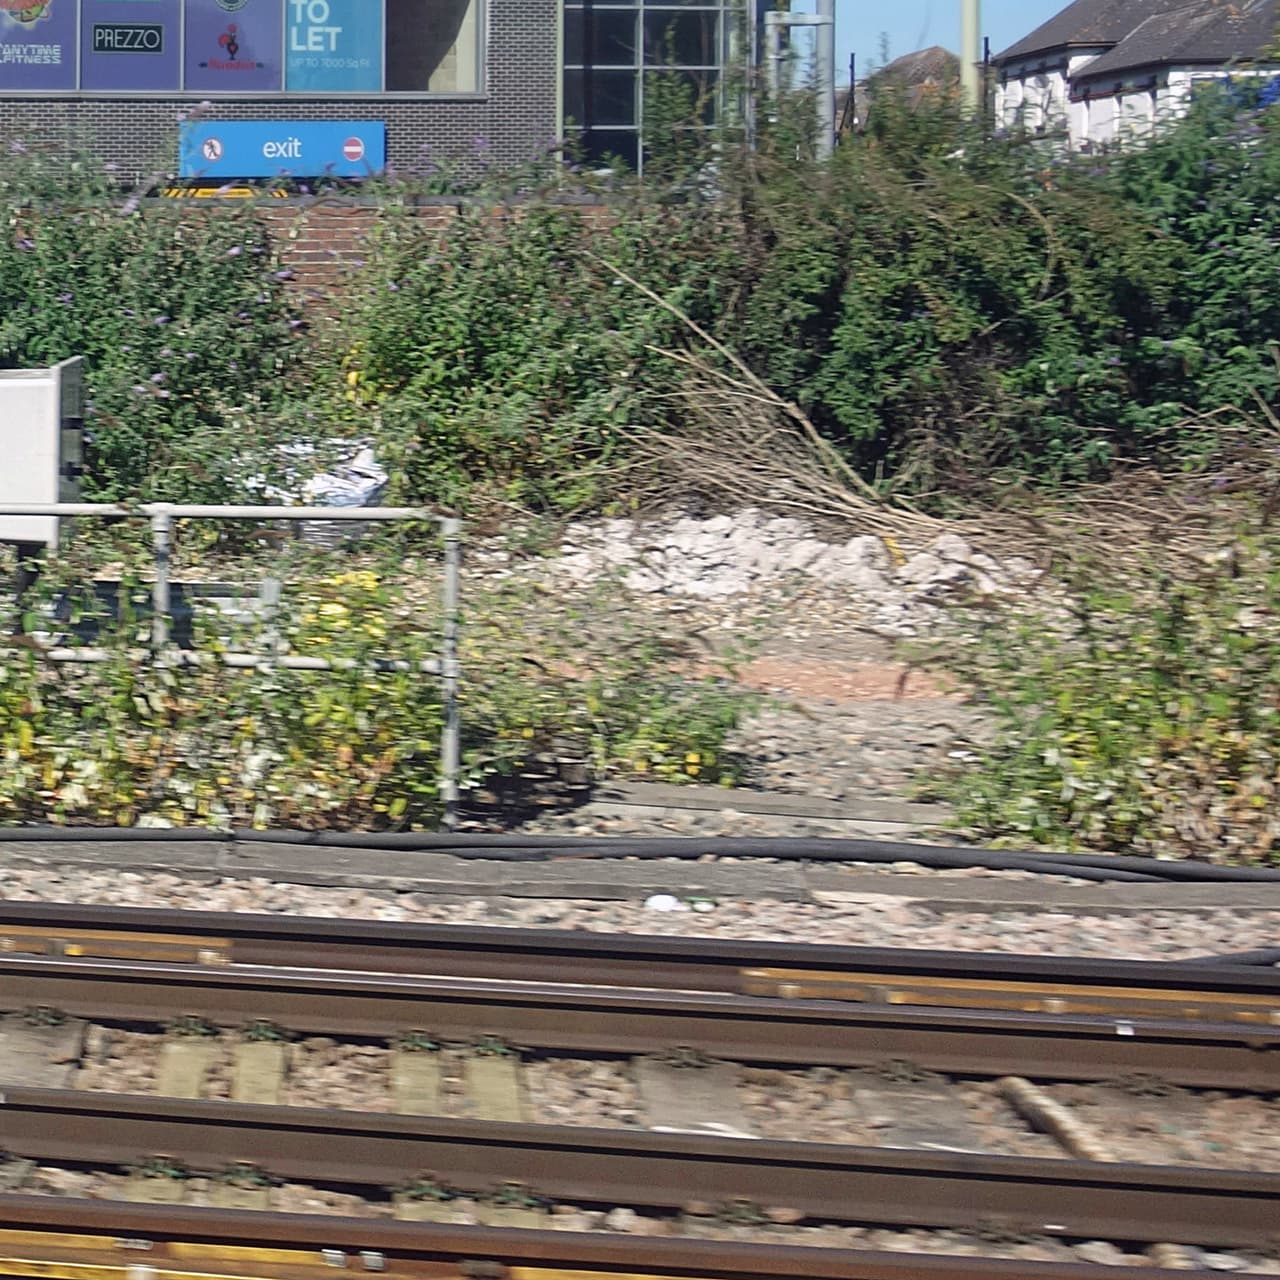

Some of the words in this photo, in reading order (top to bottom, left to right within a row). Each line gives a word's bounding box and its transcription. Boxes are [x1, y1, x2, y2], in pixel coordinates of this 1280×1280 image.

[95, 29, 160, 48] PREZZO
[291, 26, 343, 52] LET
[3, 45, 62, 56] ANYTIME
[3, 55, 62, 64] FITNESS
[263, 137, 302, 158] exit
